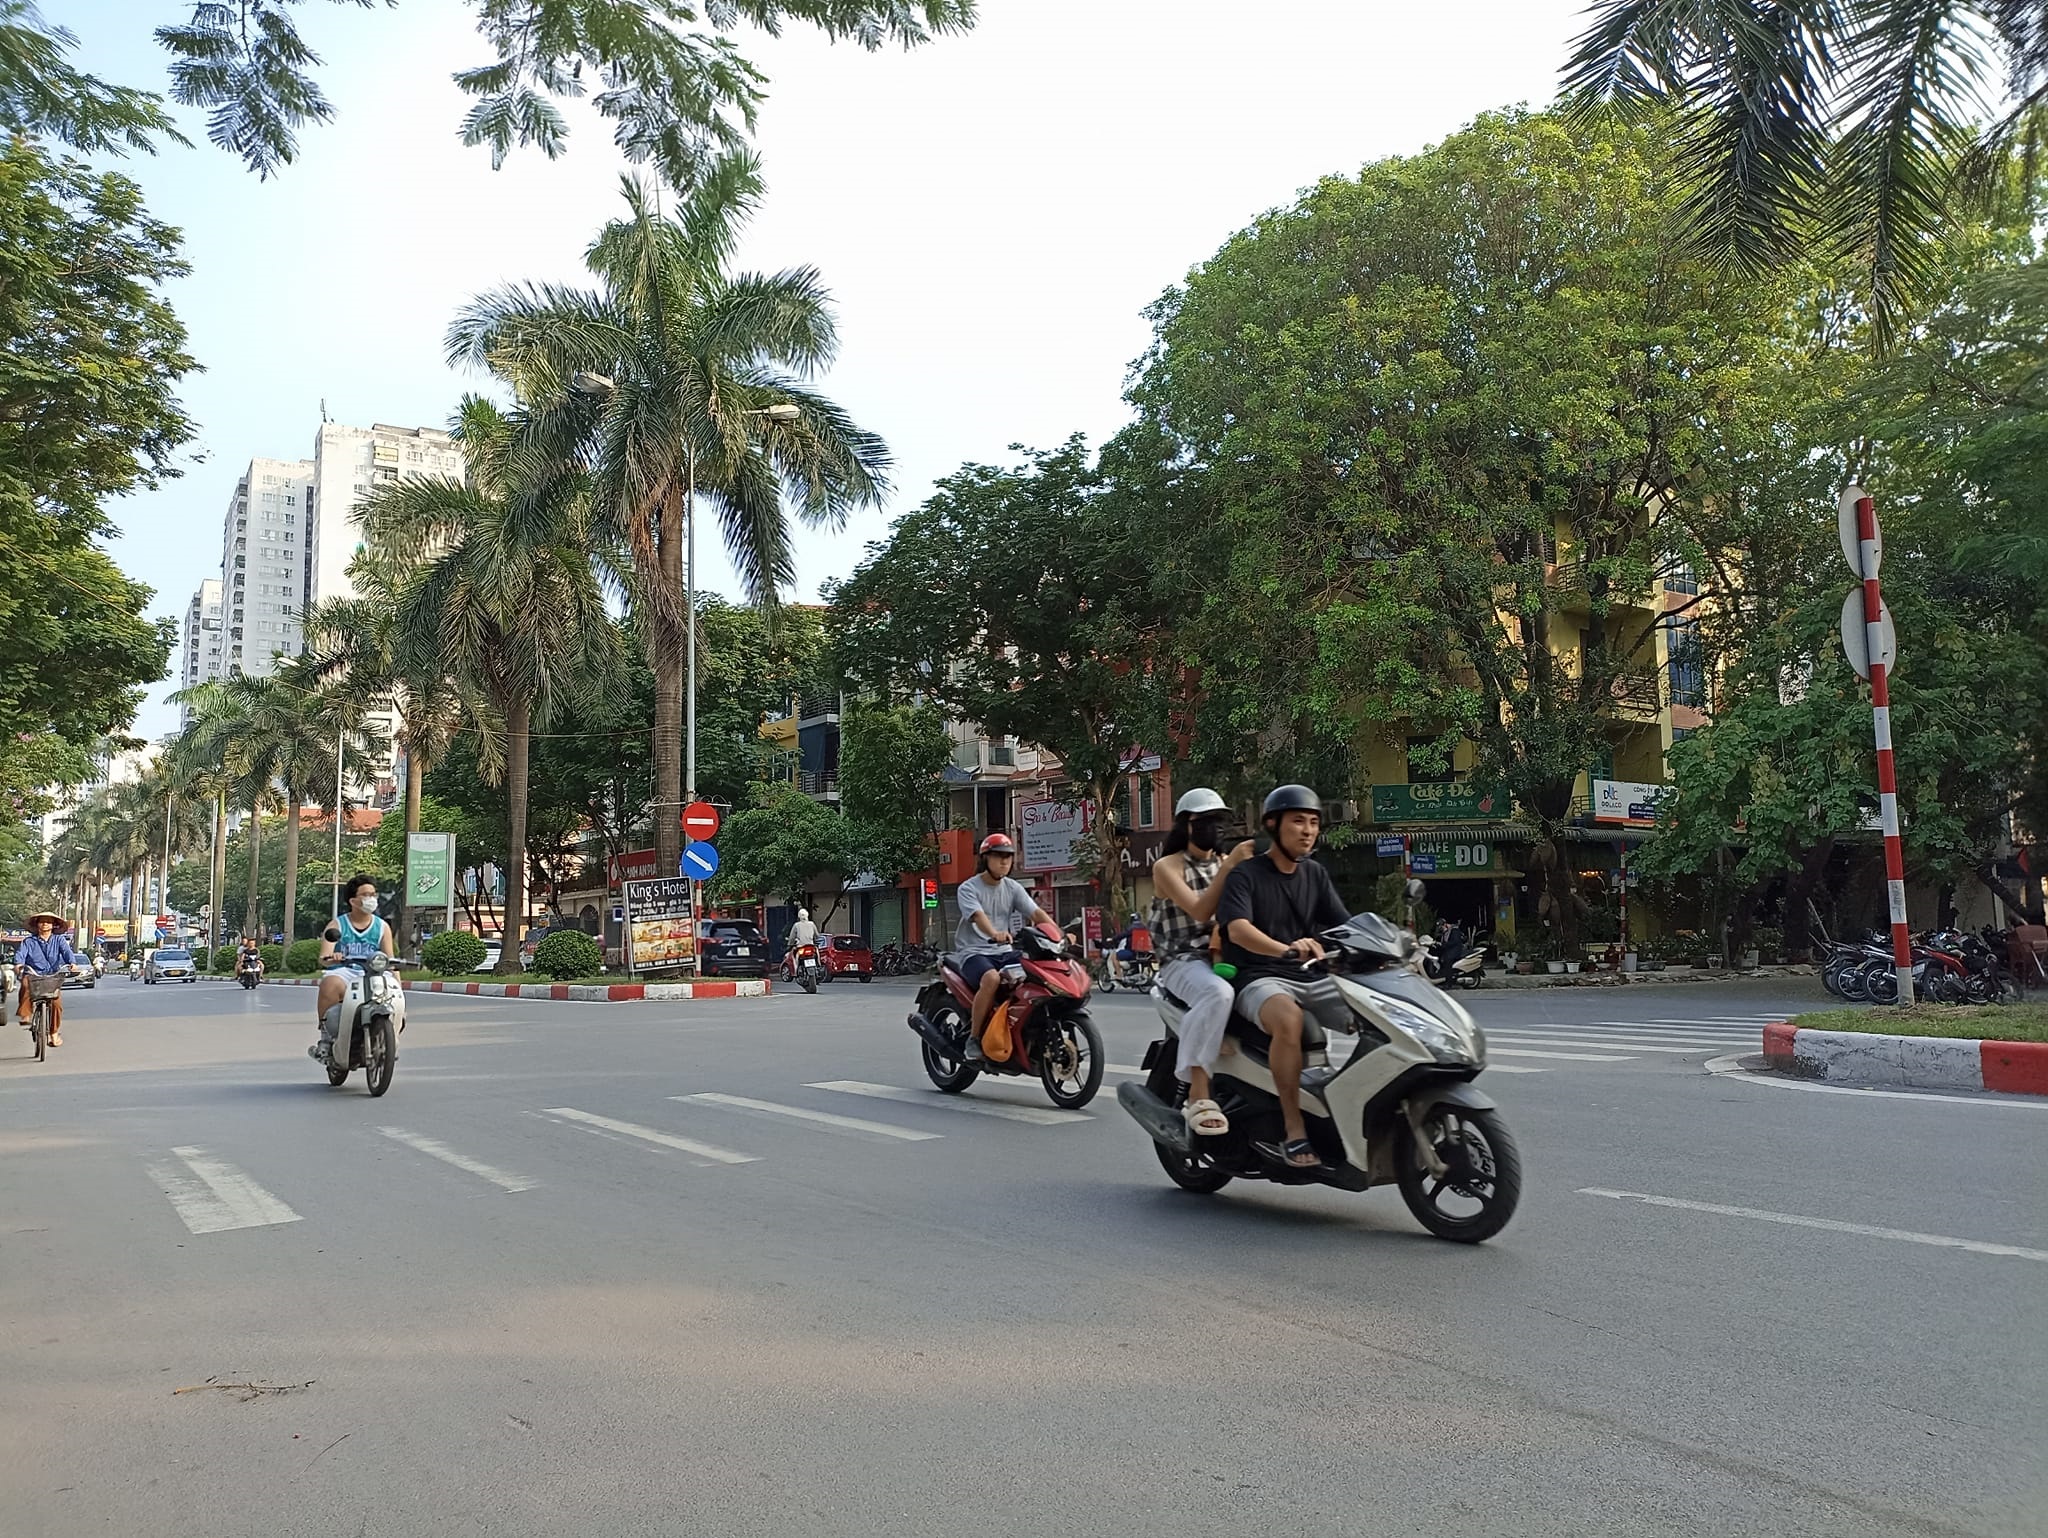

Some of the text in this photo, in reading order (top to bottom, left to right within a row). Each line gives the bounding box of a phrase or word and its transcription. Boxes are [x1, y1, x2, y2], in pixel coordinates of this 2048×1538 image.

[1419, 842, 1450, 853] CAFE
[629, 880, 689, 902] King's Hotel
